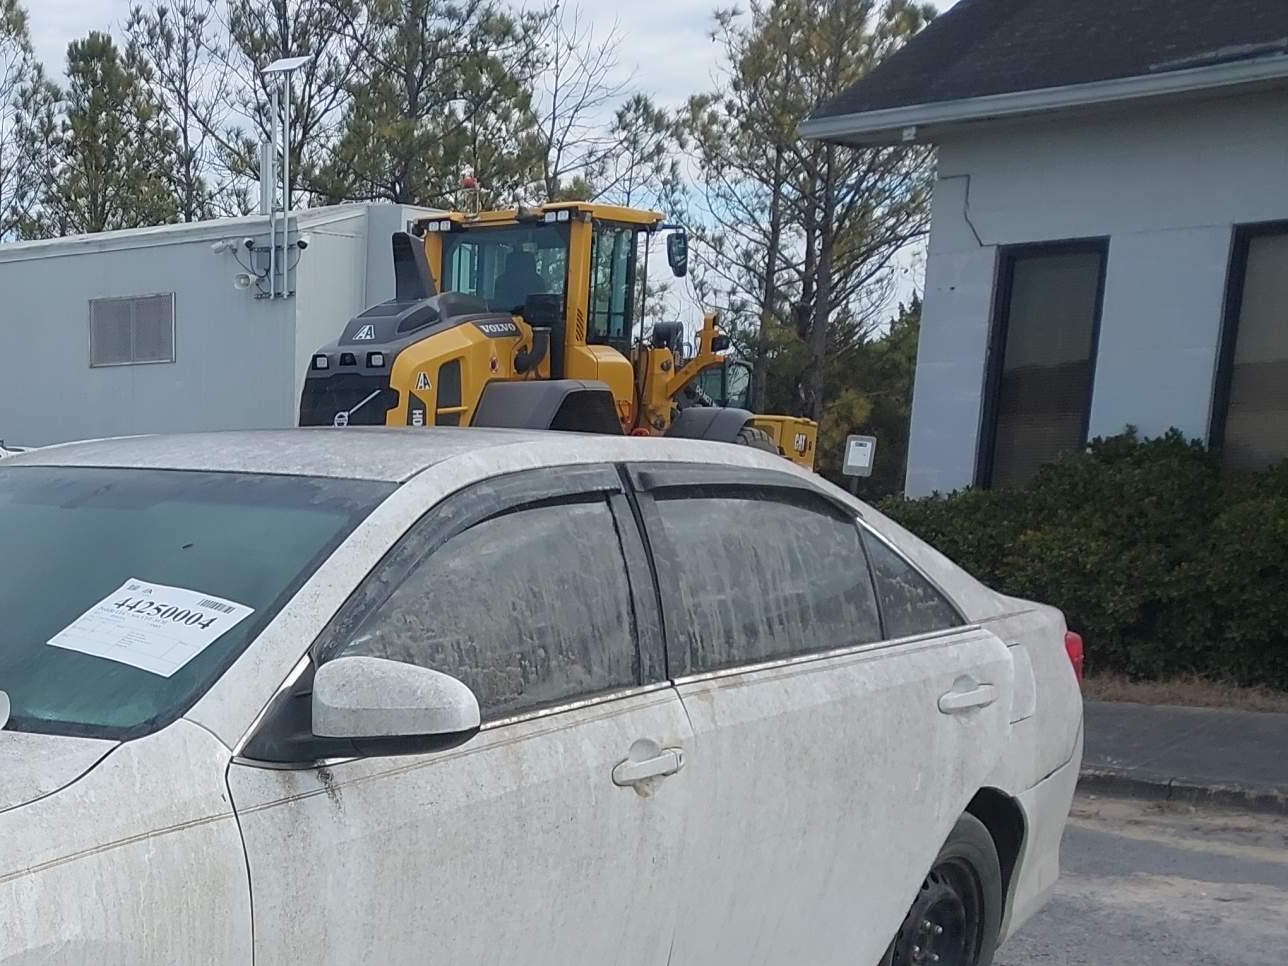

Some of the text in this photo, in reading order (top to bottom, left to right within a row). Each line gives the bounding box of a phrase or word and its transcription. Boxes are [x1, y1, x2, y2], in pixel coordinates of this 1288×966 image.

[480, 323, 516, 334] VOLVO
[794, 433, 807, 452] CAT
[114, 597, 218, 630] 44250004
